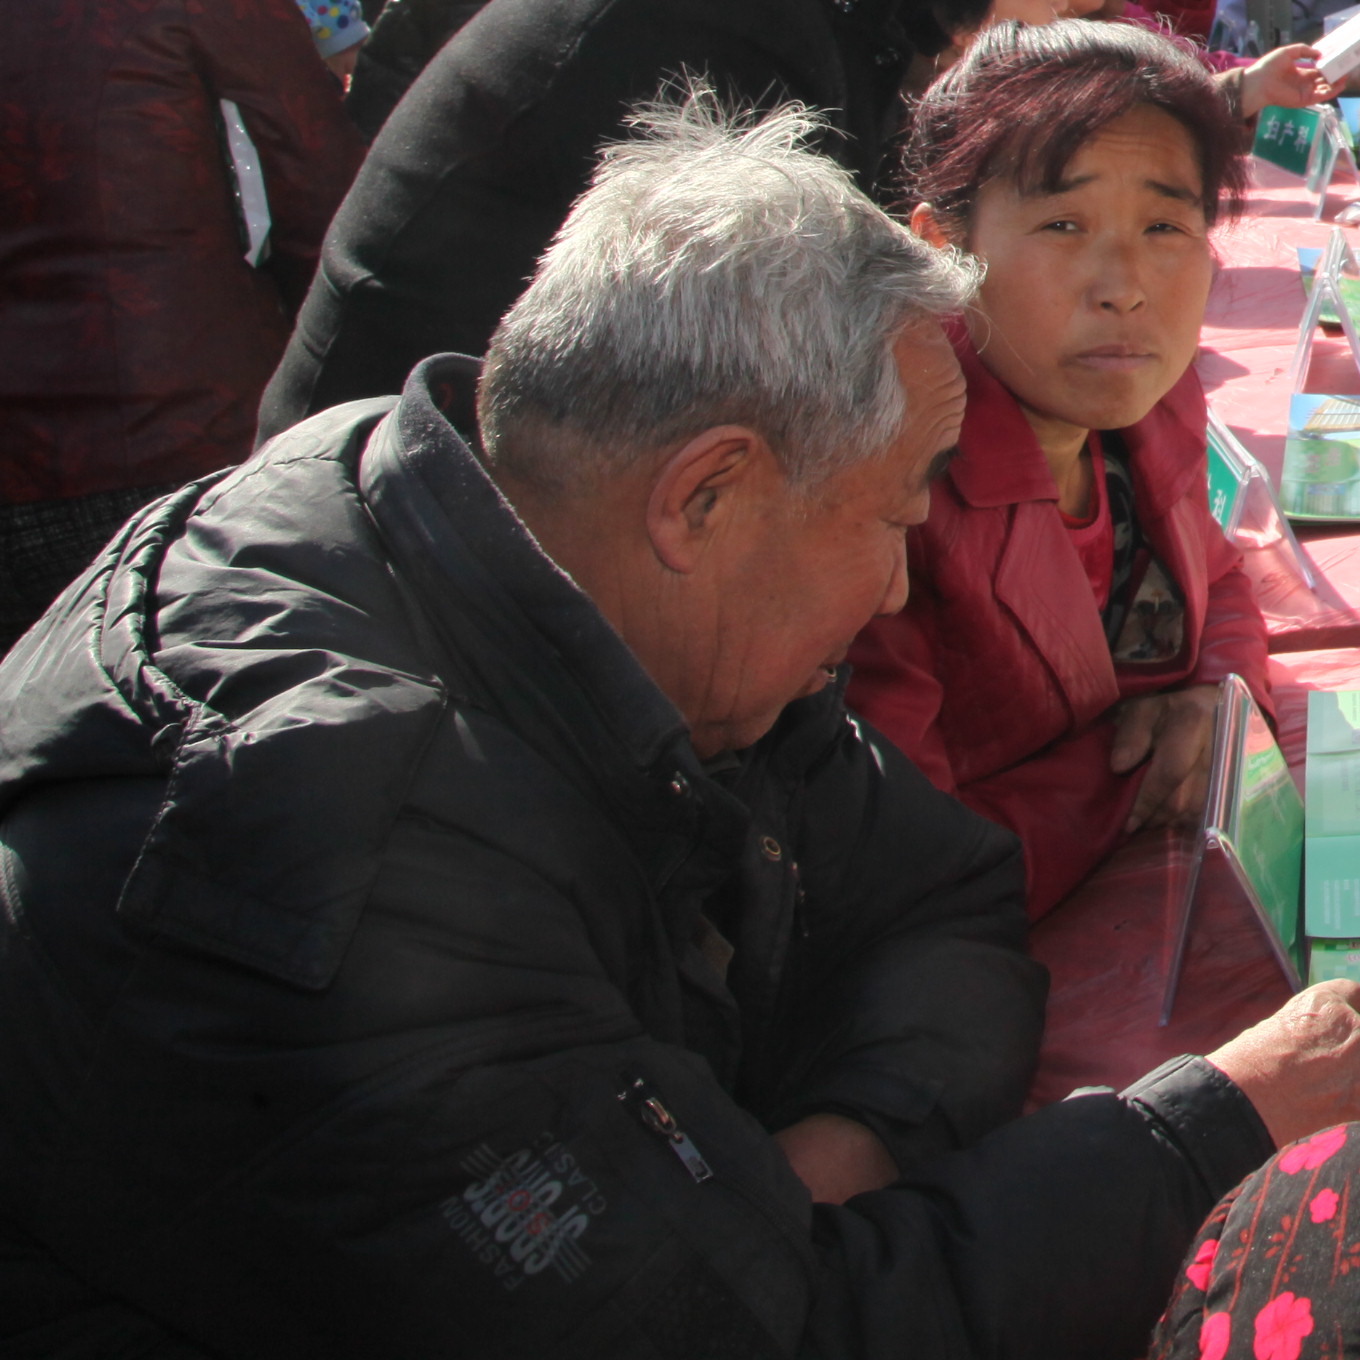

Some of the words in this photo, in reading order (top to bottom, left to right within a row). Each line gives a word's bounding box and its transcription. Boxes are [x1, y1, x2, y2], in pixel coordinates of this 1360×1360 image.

[1264, 115, 1310, 153] 妇产科
[438, 1195, 525, 1291] FASHION
